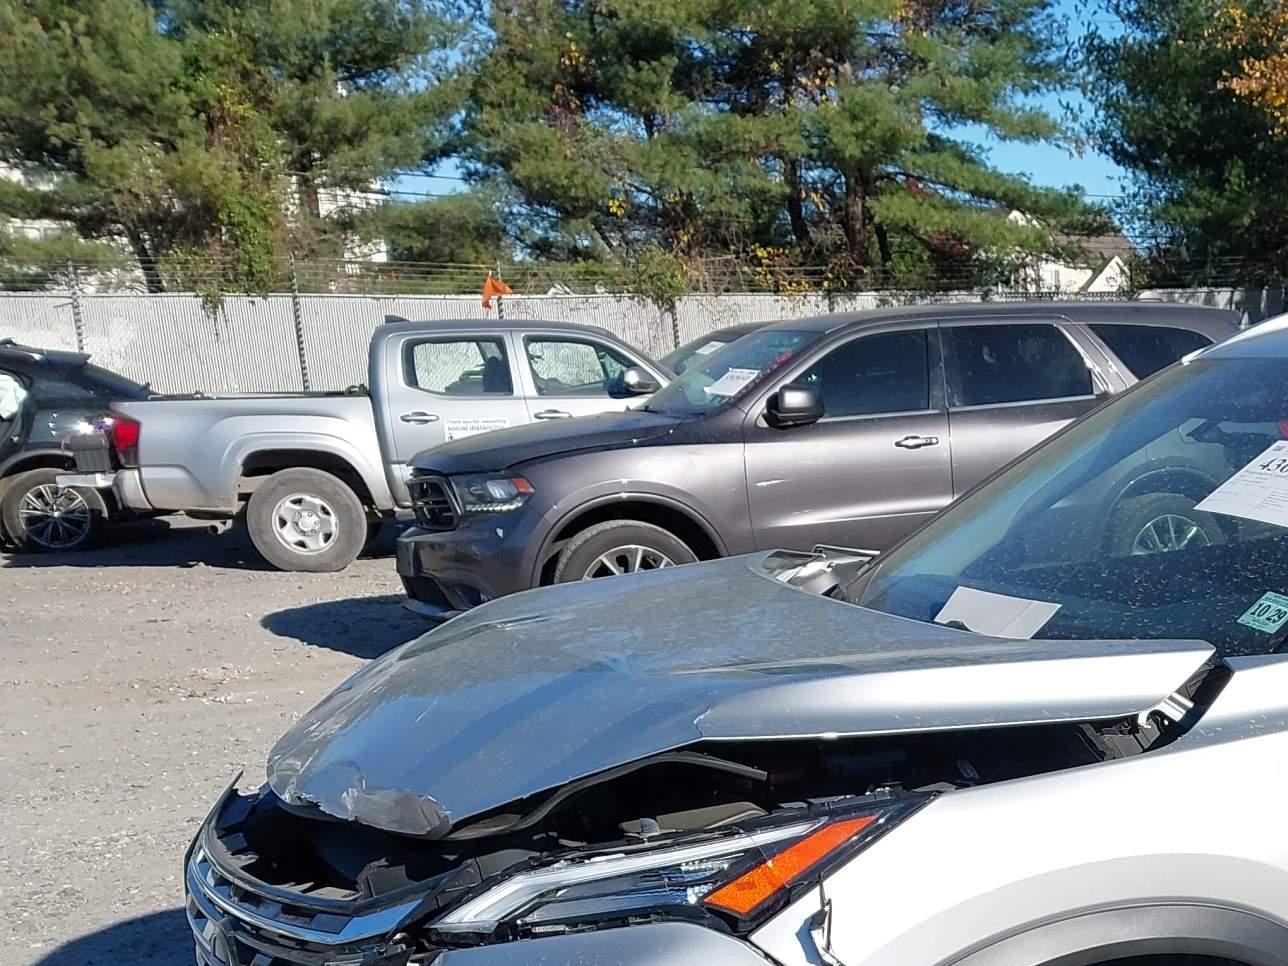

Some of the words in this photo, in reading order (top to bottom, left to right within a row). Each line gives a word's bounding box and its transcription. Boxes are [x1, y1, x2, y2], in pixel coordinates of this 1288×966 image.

[447, 424, 468, 432] social
[1250, 602, 1272, 618] 10
[1265, 608, 1288, 624] 29
